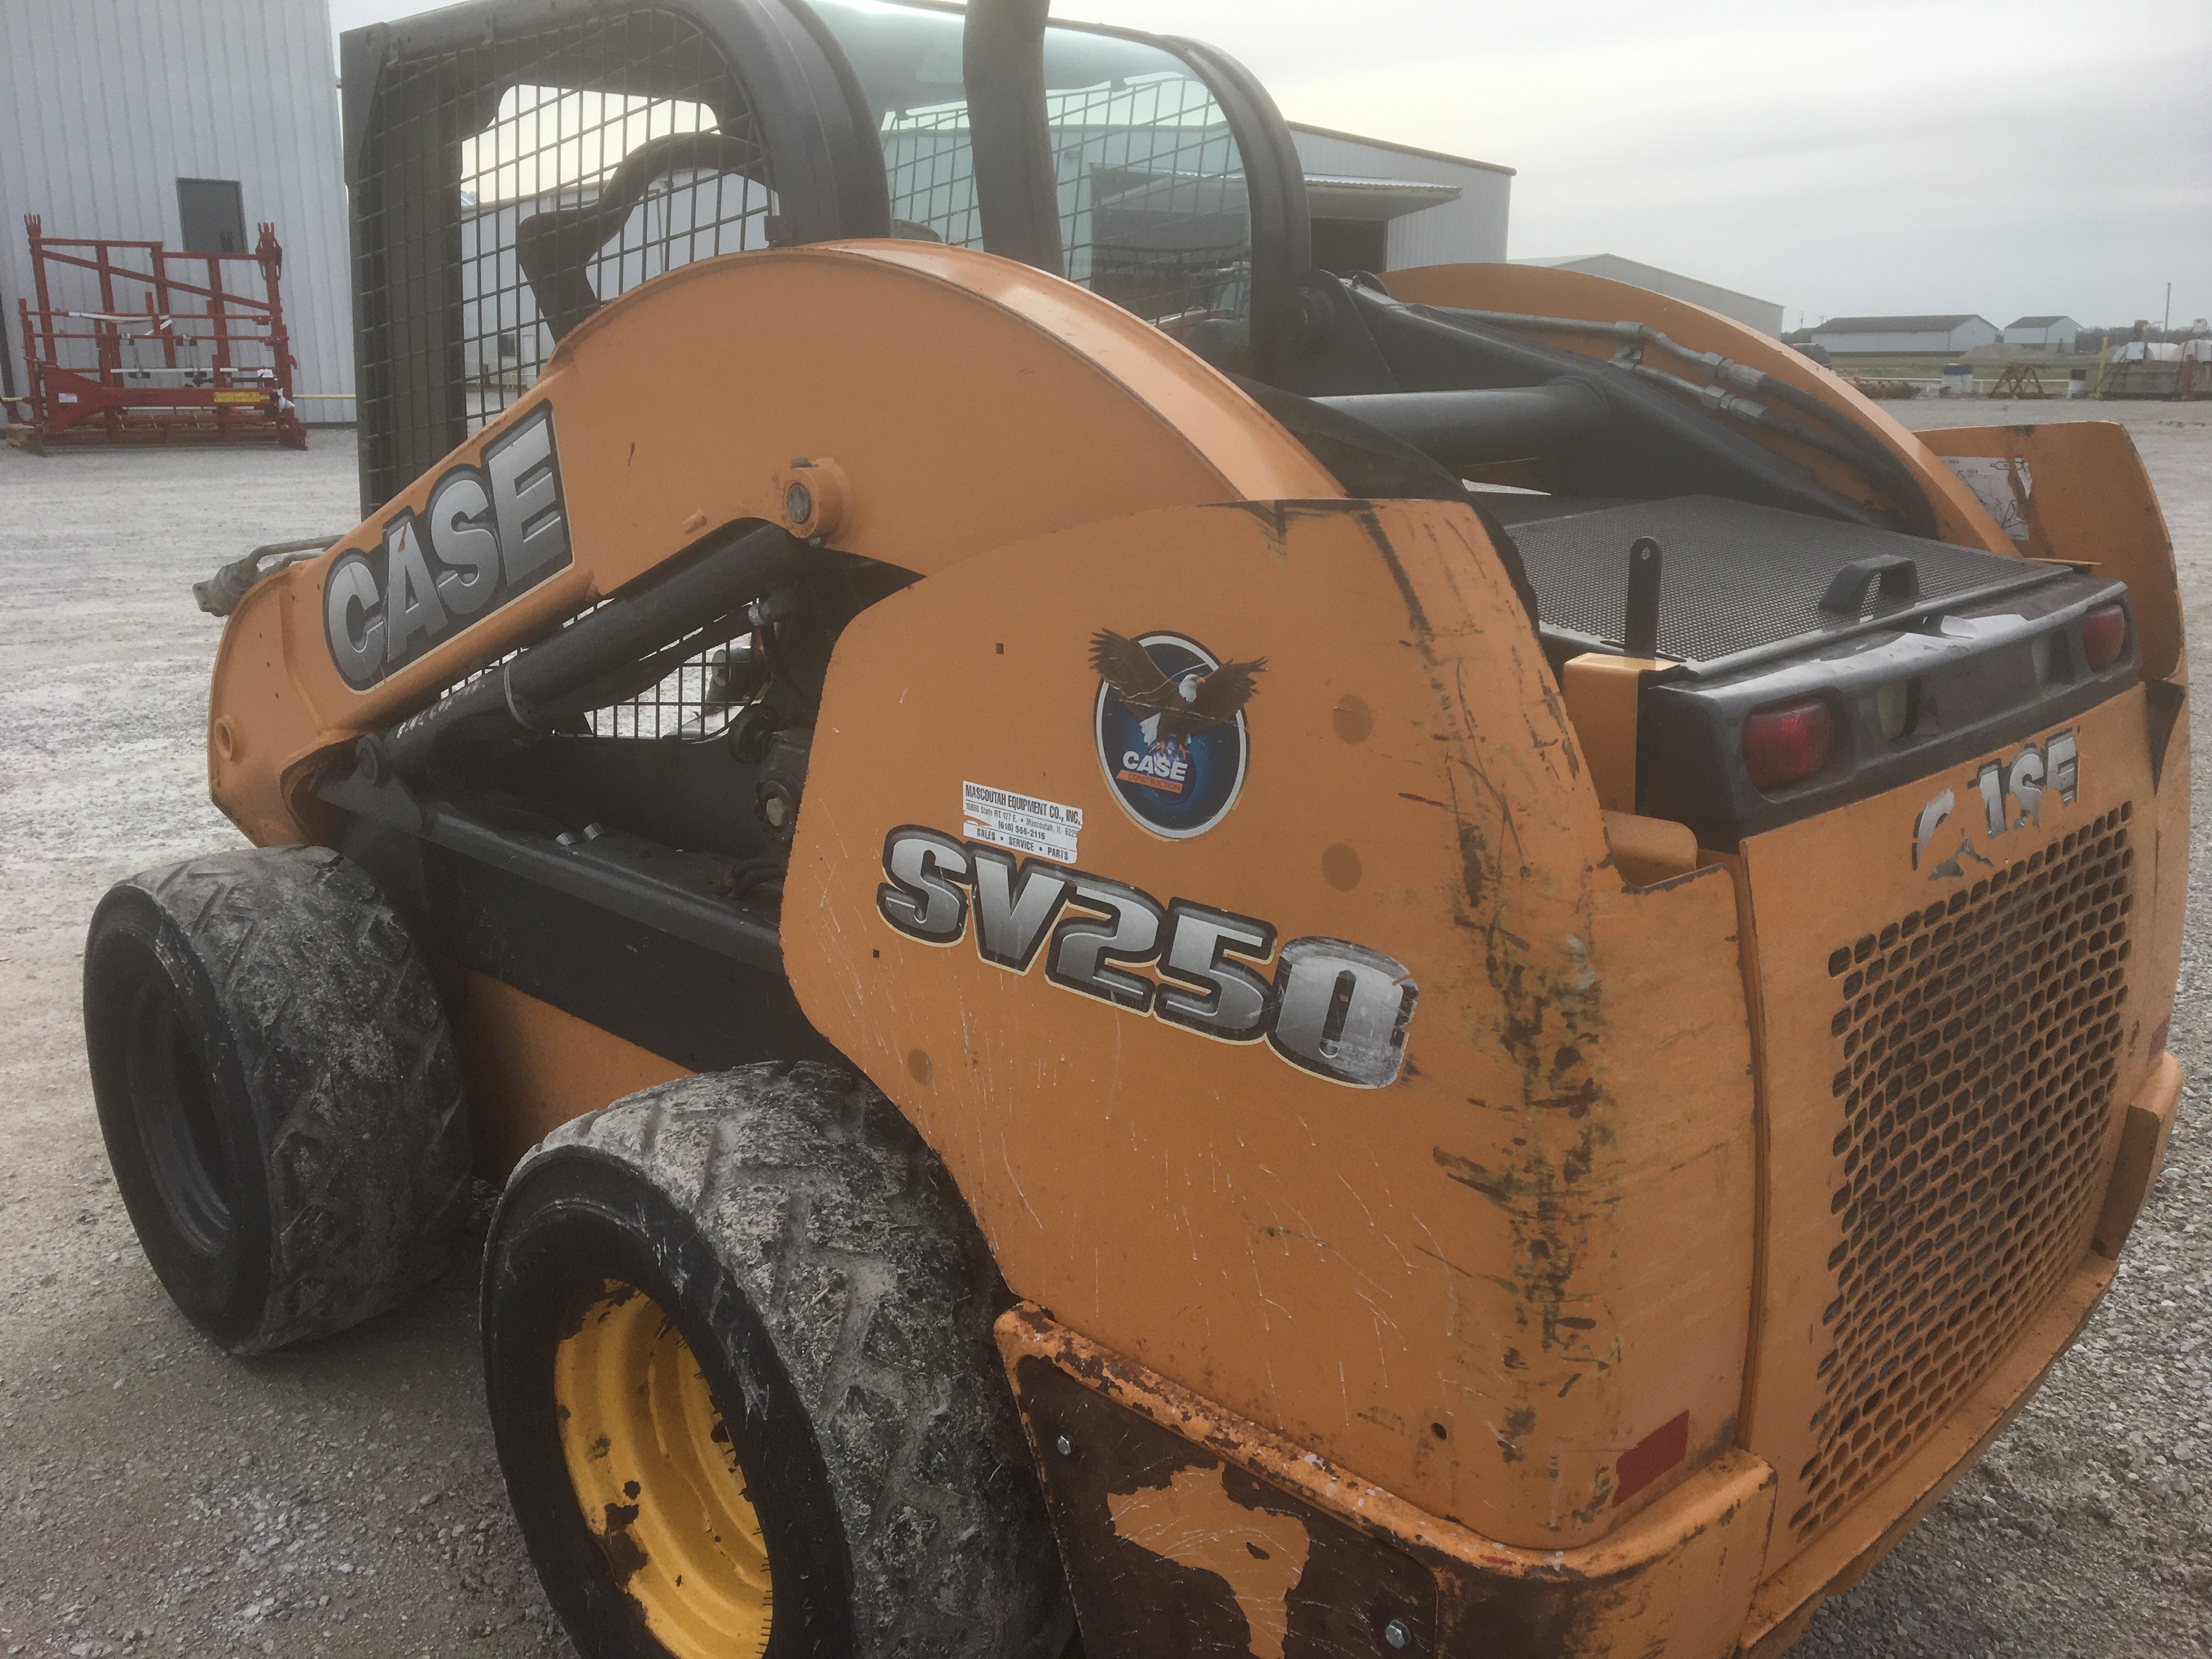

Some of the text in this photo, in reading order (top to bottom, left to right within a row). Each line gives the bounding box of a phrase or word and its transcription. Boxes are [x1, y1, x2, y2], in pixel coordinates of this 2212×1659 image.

[324, 399, 574, 692] CASE
[1123, 751, 1188, 781] CASE
[1128, 772, 1182, 791] CONSTRUCTION
[966, 784, 1081, 825] MASCOUTAH EQUIPMENT CO., INC.
[980, 806, 993, 816] State
[1003, 812, 1011, 821] 177
[977, 827, 1069, 861] SALES SERVICE PARTS
[998, 820, 1046, 840] (618) 566-2115
[878, 825, 1419, 1090] SV250
